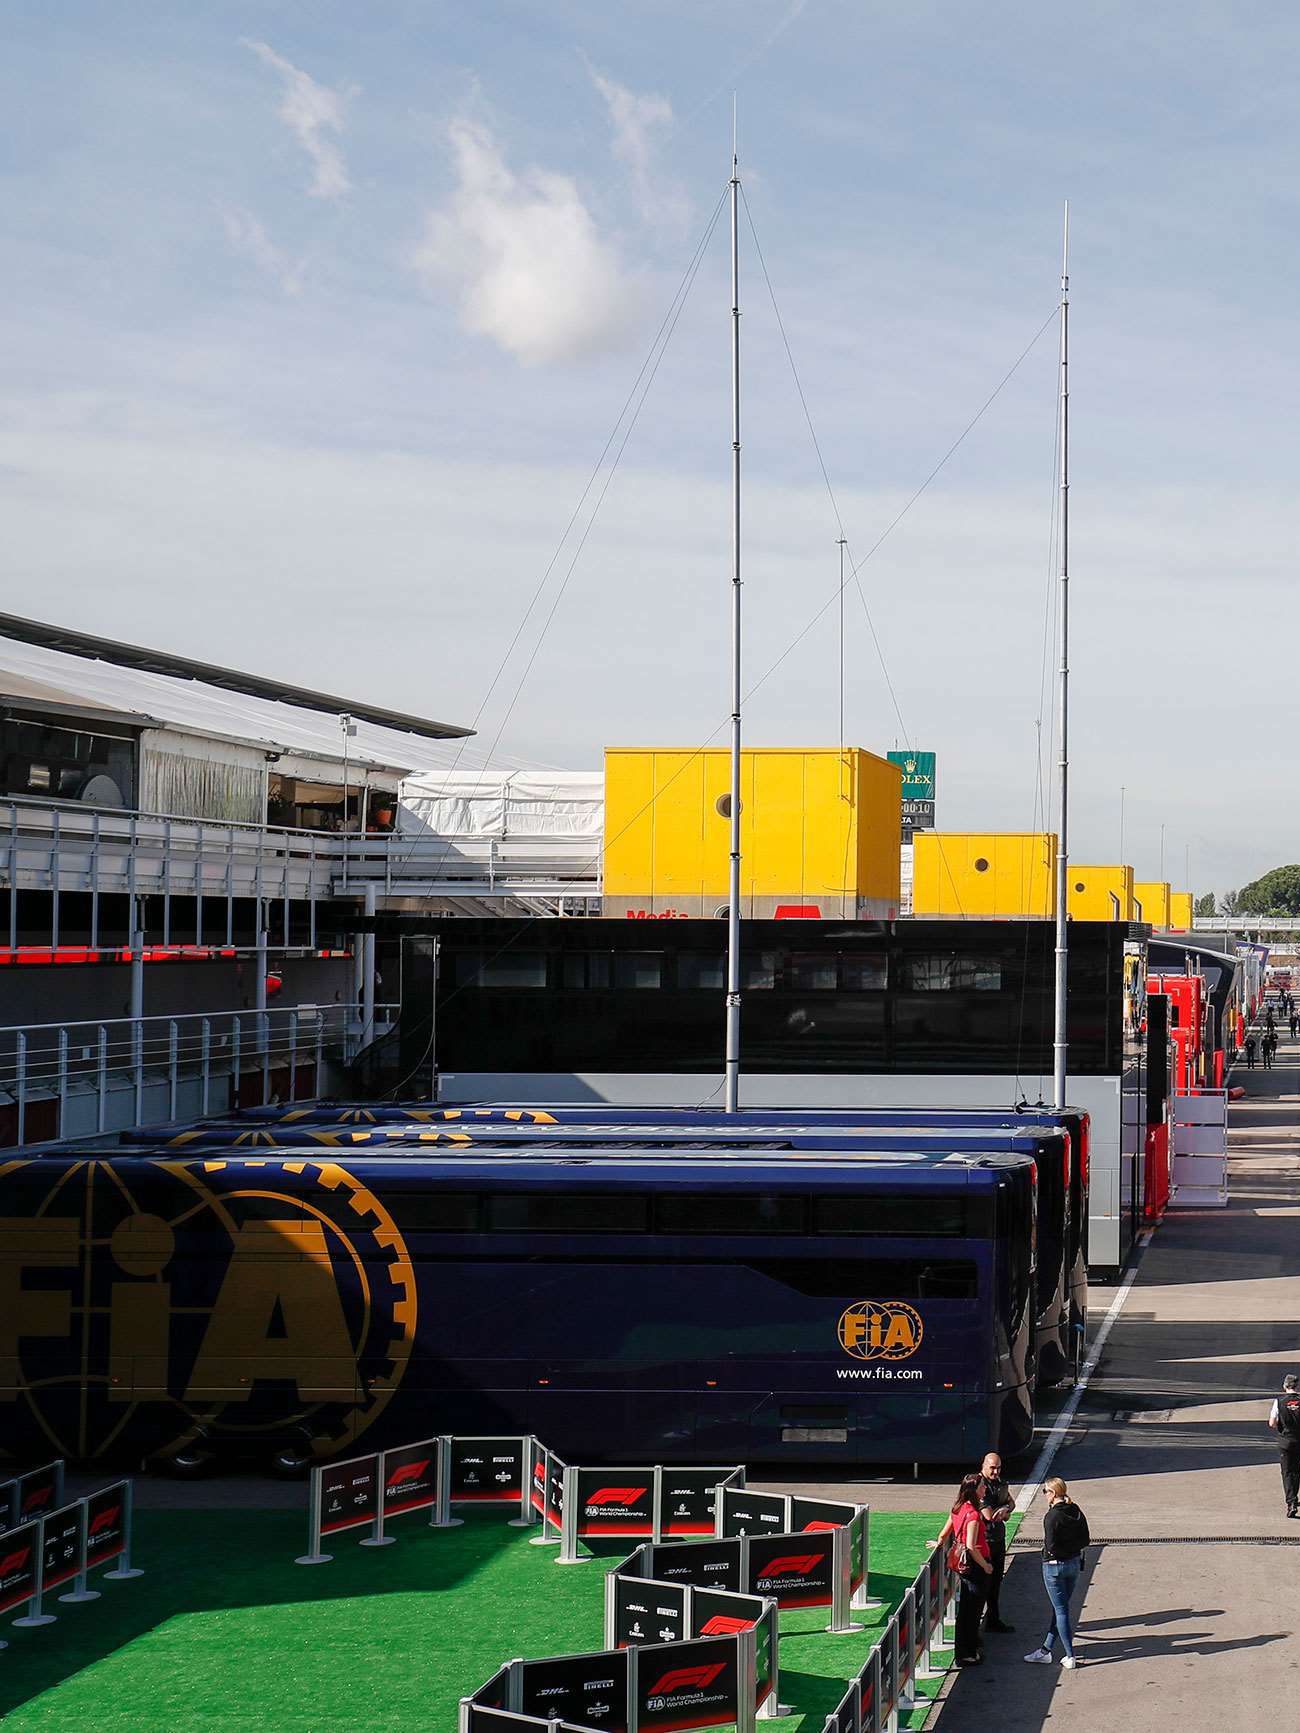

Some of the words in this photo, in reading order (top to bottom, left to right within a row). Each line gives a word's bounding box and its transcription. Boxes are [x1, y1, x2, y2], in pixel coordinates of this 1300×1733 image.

[901, 774, 931, 784] OLEX
[836, 1367, 923, 1379] www.fia.com
[703, 1562, 730, 1571] PIRELLI
[583, 1679, 614, 1690] PIRELLI
[684, 1694, 724, 1704] Championship
